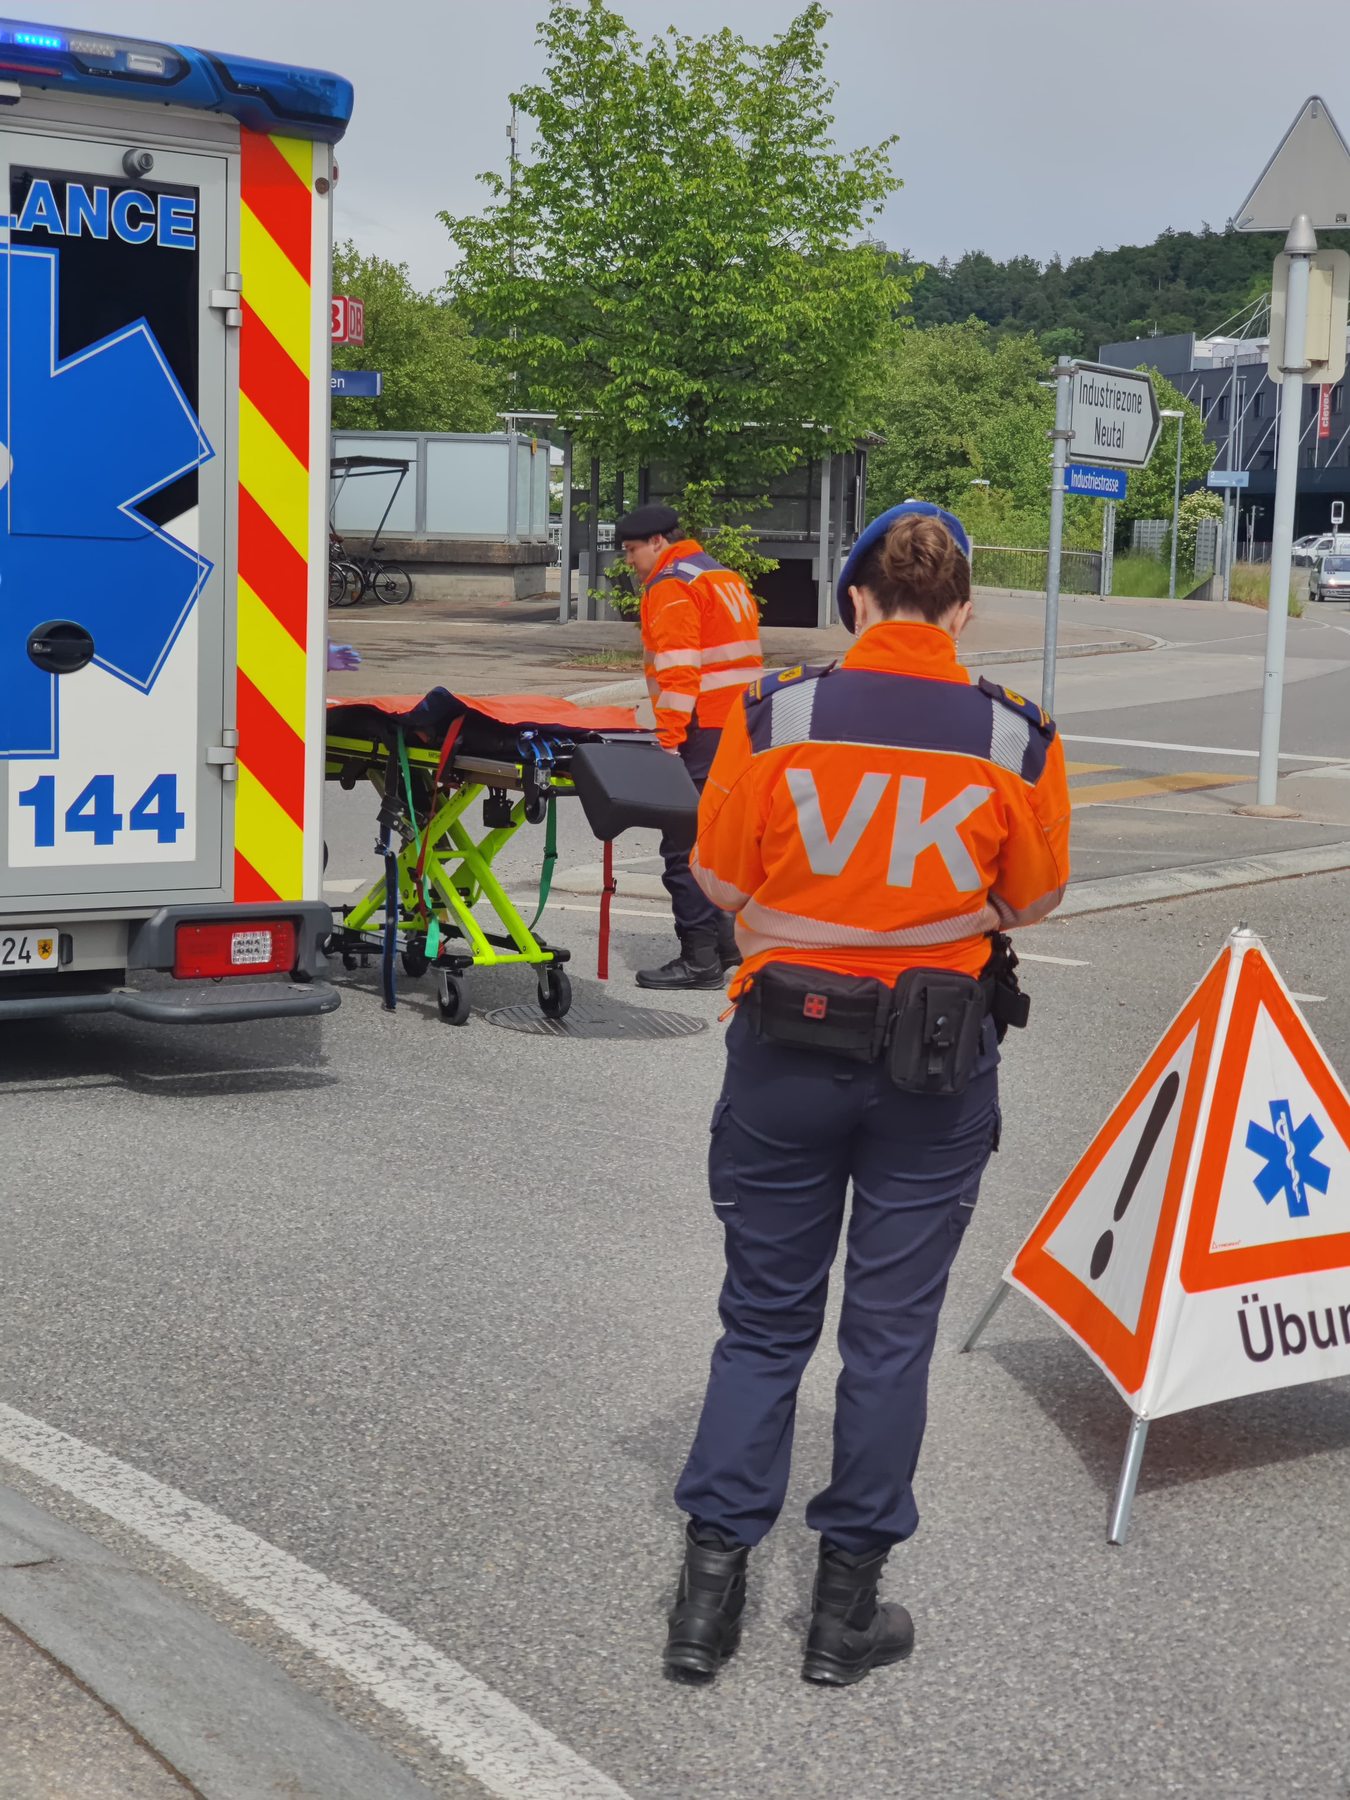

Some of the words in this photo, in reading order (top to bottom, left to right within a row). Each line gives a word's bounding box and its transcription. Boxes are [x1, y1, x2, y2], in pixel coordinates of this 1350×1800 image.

[349, 304, 362, 337] DB
[1079, 375, 1142, 414] Industriezone
[1094, 416, 1125, 449] Neutal
[1070, 469, 1119, 493] Industriestrasse
[713, 582, 755, 623] VK
[18, 774, 185, 847] 144
[785, 768, 996, 892] VK
[2, 936, 32, 965] 24
